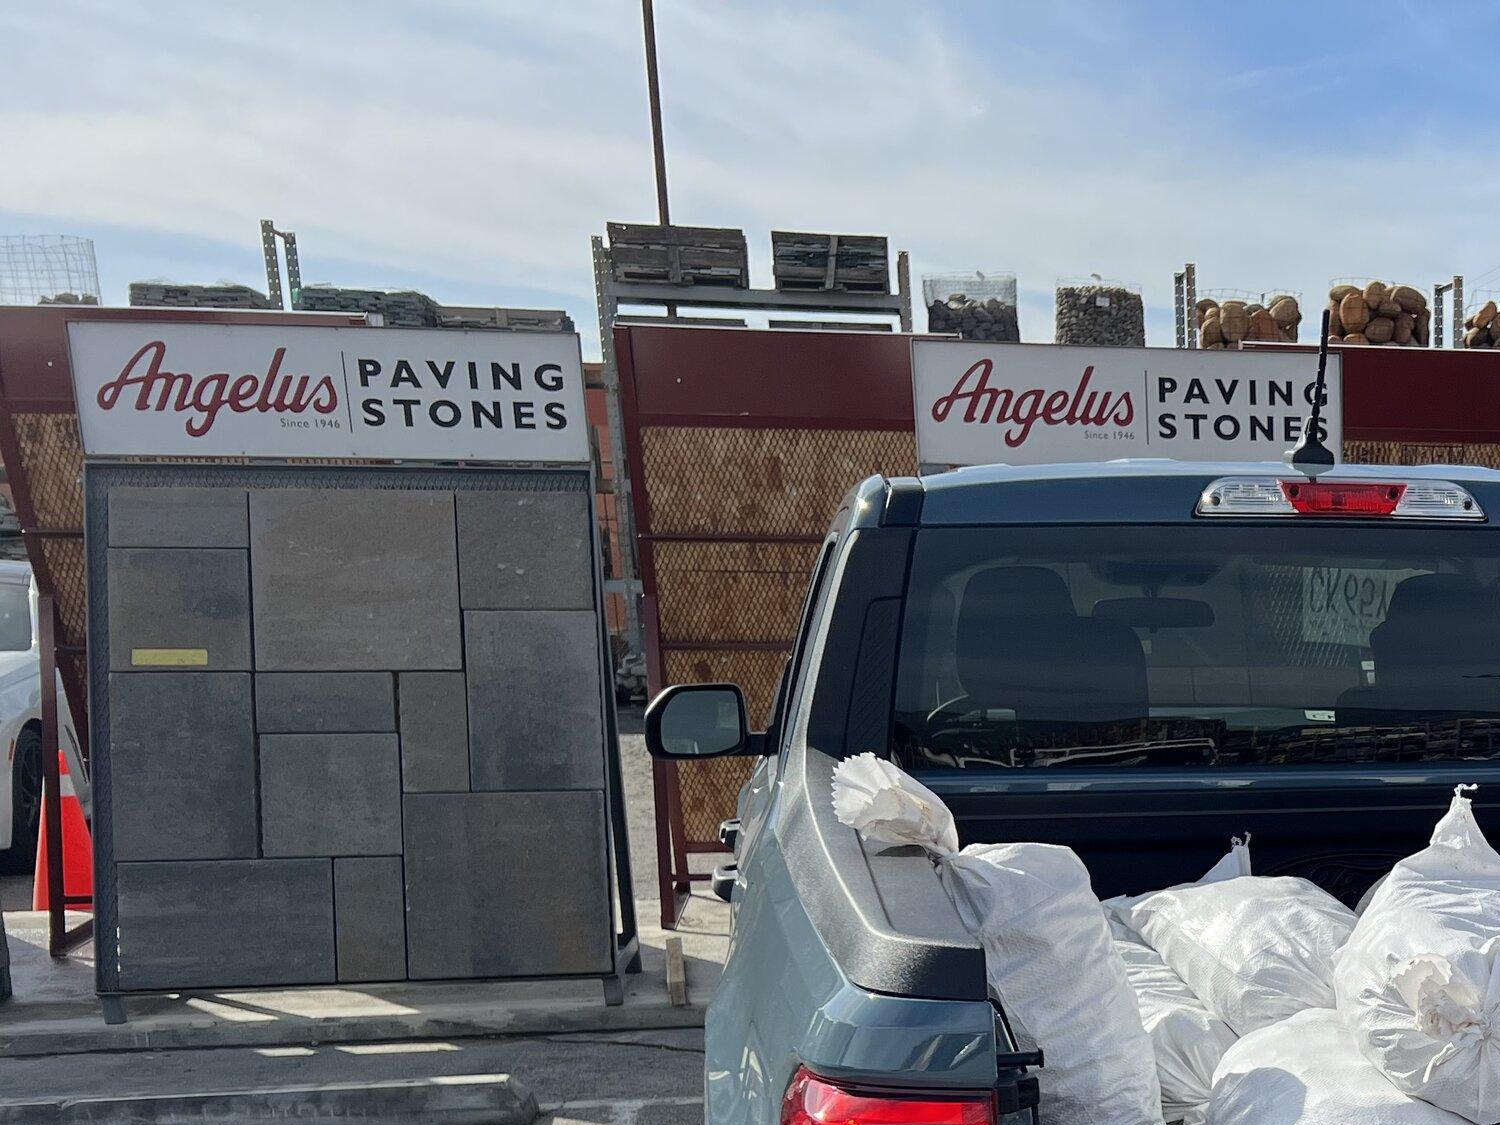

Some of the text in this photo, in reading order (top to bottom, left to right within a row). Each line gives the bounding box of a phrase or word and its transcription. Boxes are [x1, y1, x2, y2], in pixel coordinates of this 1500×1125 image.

[96, 340, 338, 437] Angelus
[357, 358, 564, 392] PAVING
[931, 358, 1134, 448] Angelus
[1157, 376, 1329, 408] PAVING
[279, 417, 341, 430] Since 1946
[361, 398, 568, 430] STONES
[1083, 429, 1135, 441] Since 1946
